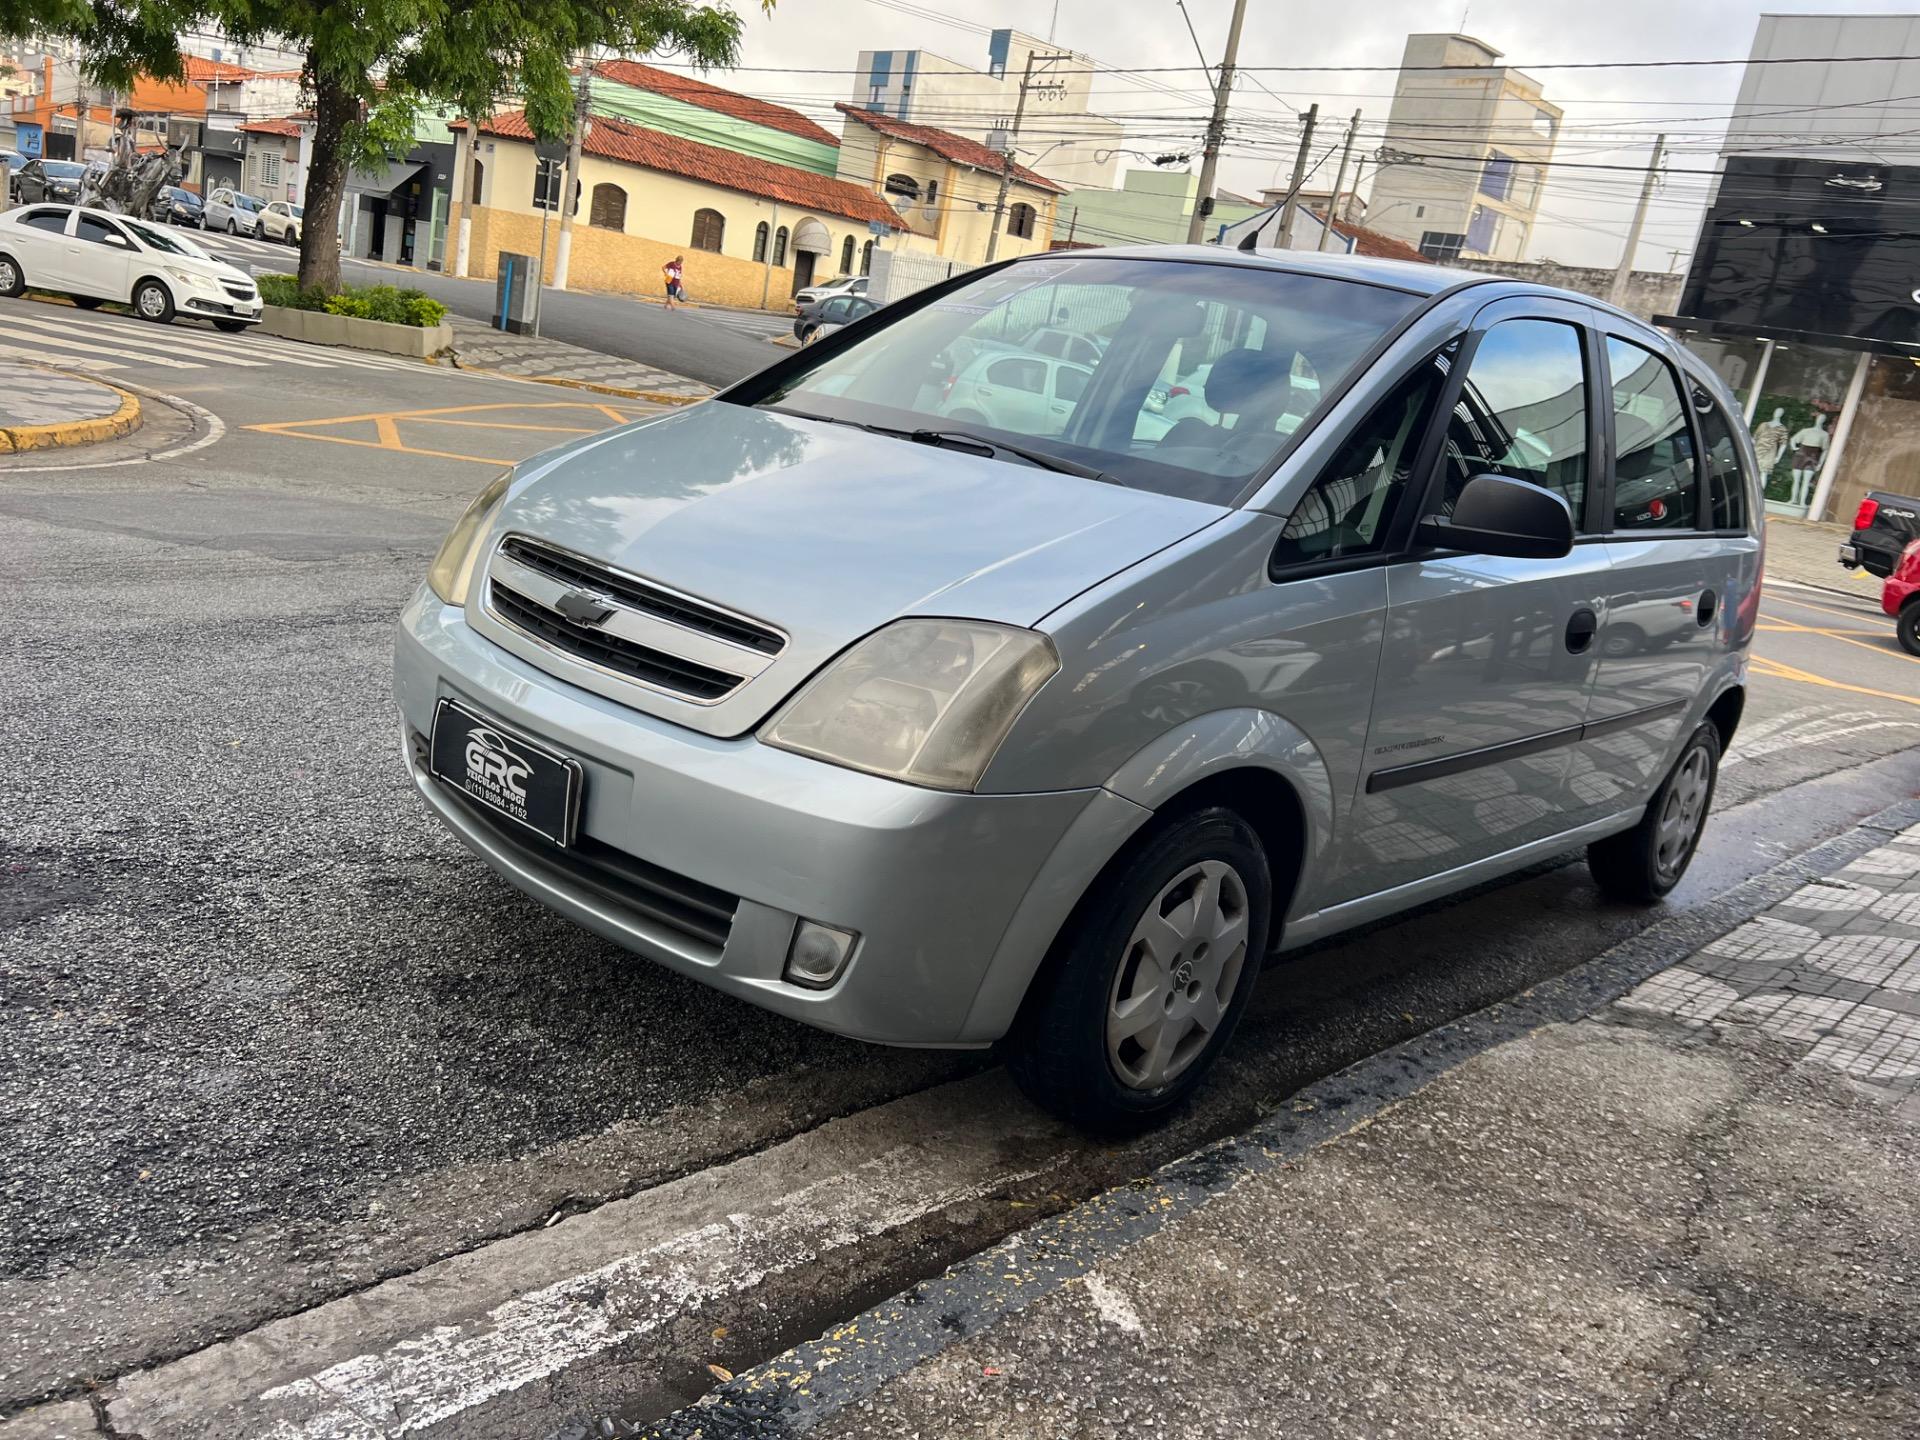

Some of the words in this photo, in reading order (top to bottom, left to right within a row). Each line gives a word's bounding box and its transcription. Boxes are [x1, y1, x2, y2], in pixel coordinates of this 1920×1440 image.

[465, 741, 528, 798] GRC
[466, 767, 500, 793] VEICULOS
[502, 787, 525, 807] MOGI
[471, 782, 484, 798] (11)
